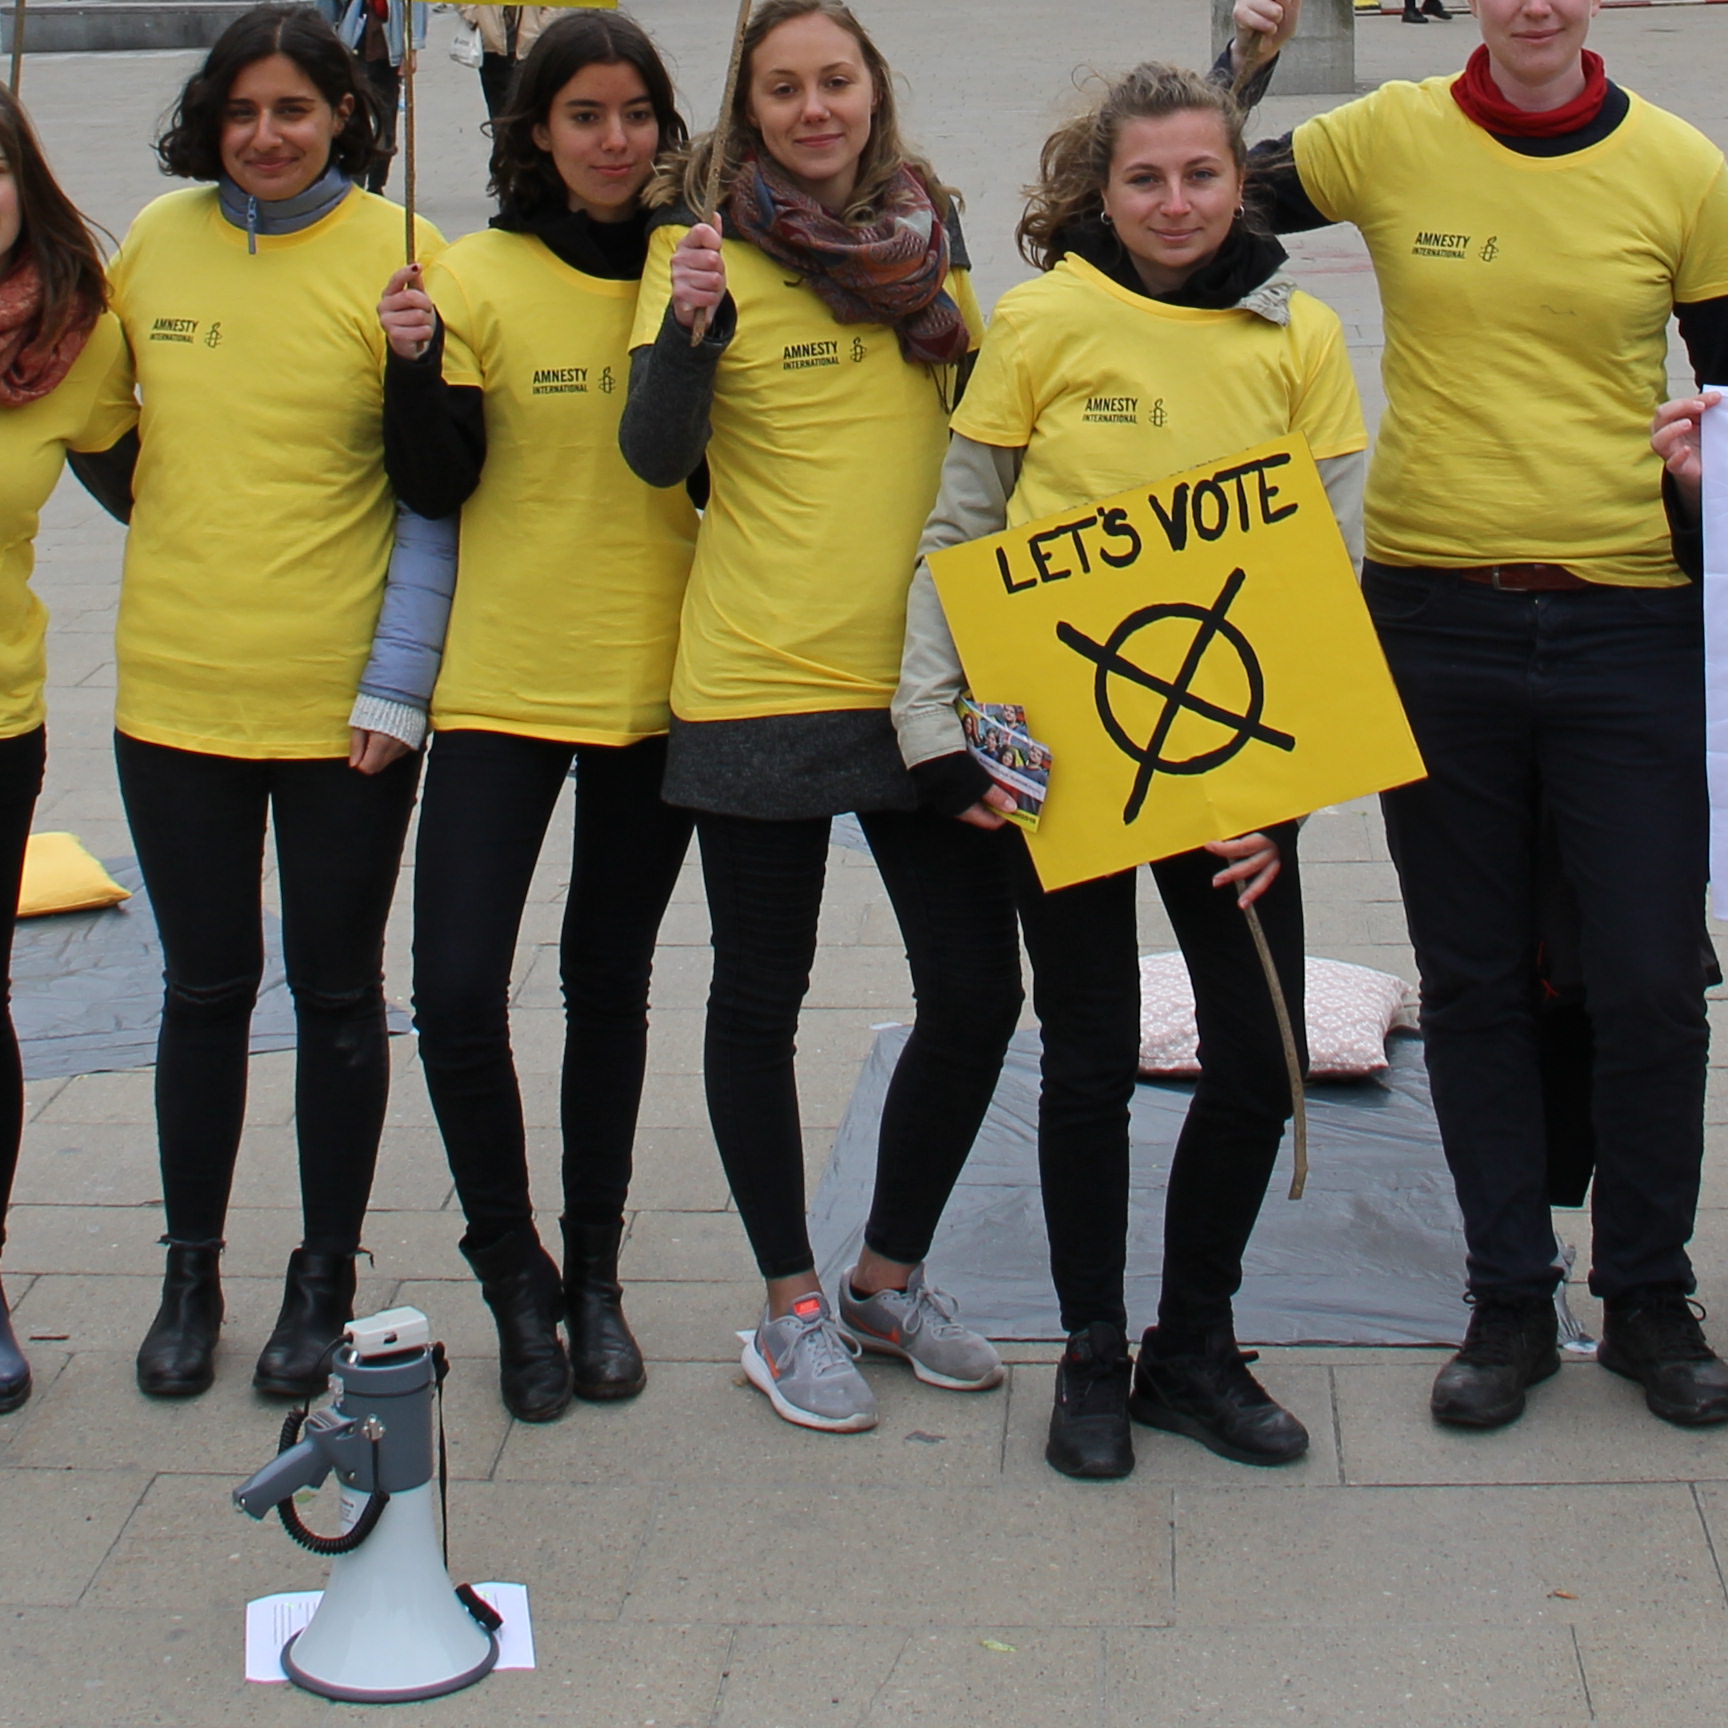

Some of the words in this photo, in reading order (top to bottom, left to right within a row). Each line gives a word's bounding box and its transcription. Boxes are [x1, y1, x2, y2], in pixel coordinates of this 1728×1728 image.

[1414, 231, 1472, 249] AMNESTY
[782, 340, 839, 360] AMNESTY
[532, 367, 589, 384] AMNESTY
[1084, 396, 1139, 413] AMNESTY
[995, 506, 1142, 595] LET'S
[1148, 452, 1299, 552] VOTE
